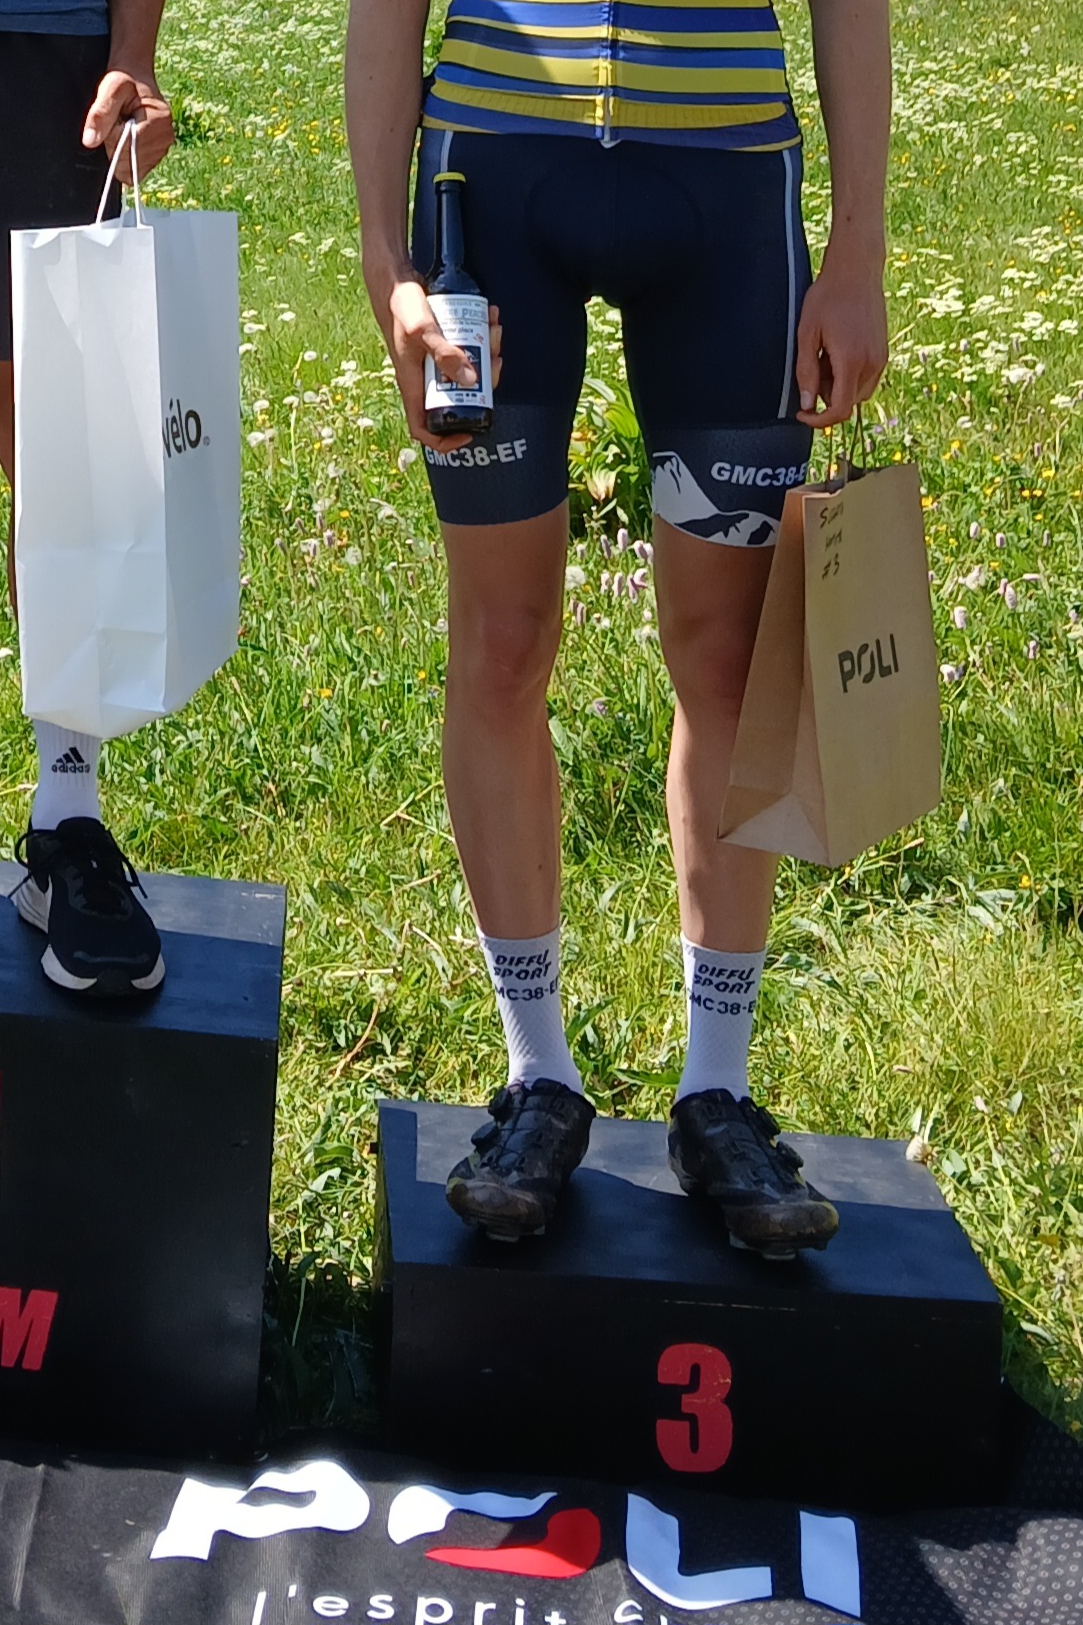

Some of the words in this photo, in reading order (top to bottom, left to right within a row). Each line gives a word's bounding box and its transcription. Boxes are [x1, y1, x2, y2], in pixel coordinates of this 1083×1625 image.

[424, 438, 527, 467] GMC38-EF
[838, 633, 899, 693] POLI
[51, 761, 91, 774] adidas
[493, 961, 552, 980] SPORT
[495, 949, 549, 967] DIFFU
[694, 974, 755, 995] SPORT
[698, 964, 755, 981] DIFFU
[656, 1342, 733, 1472] 3
[149, 1460, 861, 1618] POLI
[251, 1584, 567, 1625] l'esprit
